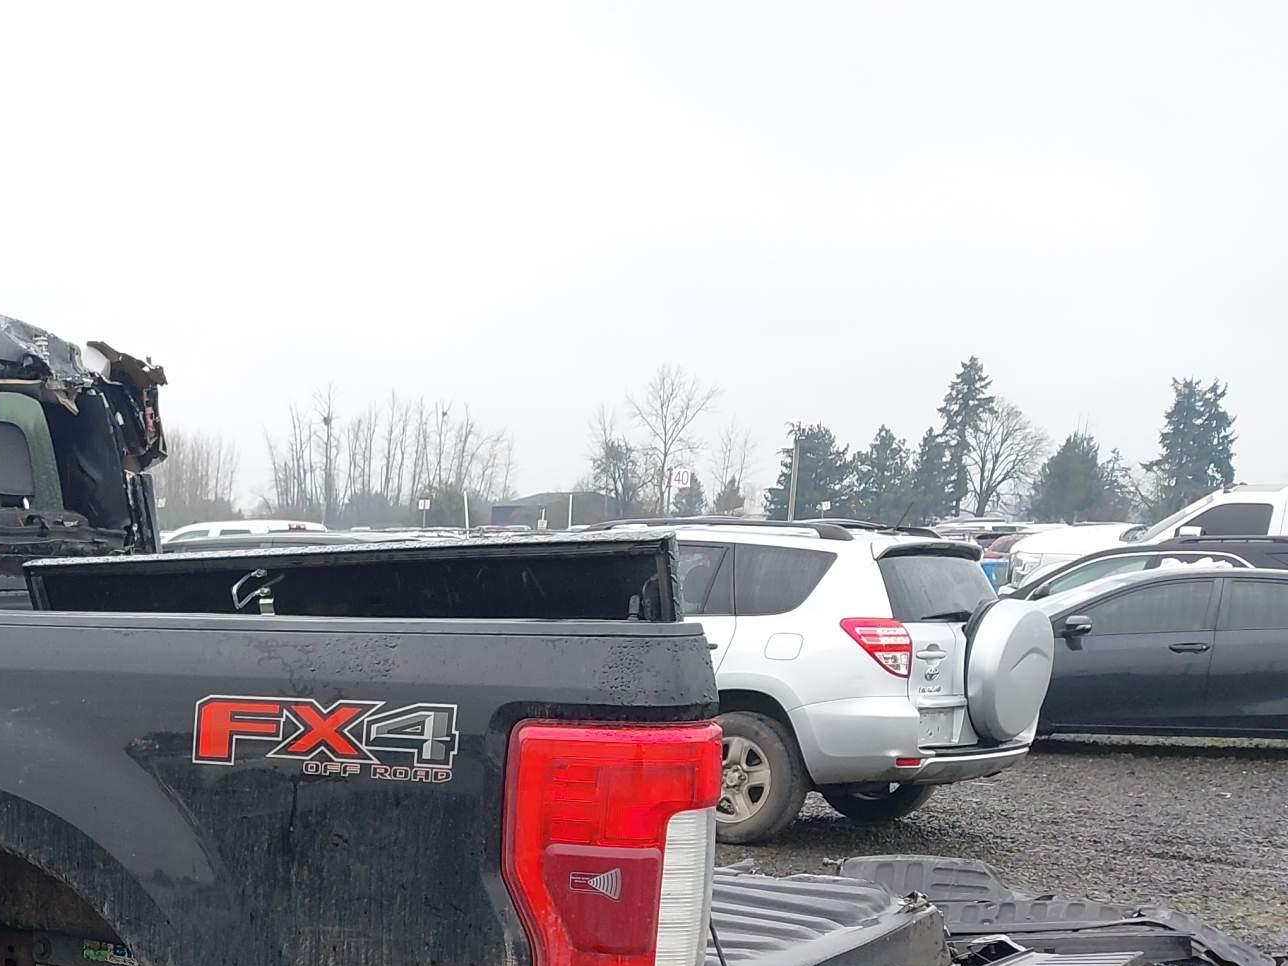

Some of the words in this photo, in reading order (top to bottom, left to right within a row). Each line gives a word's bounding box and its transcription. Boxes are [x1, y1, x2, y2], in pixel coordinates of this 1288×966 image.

[674, 470, 689, 485] 40
[192, 695, 459, 768] FX4
[303, 761, 361, 777] OFF
[371, 764, 453, 783] ROAD
